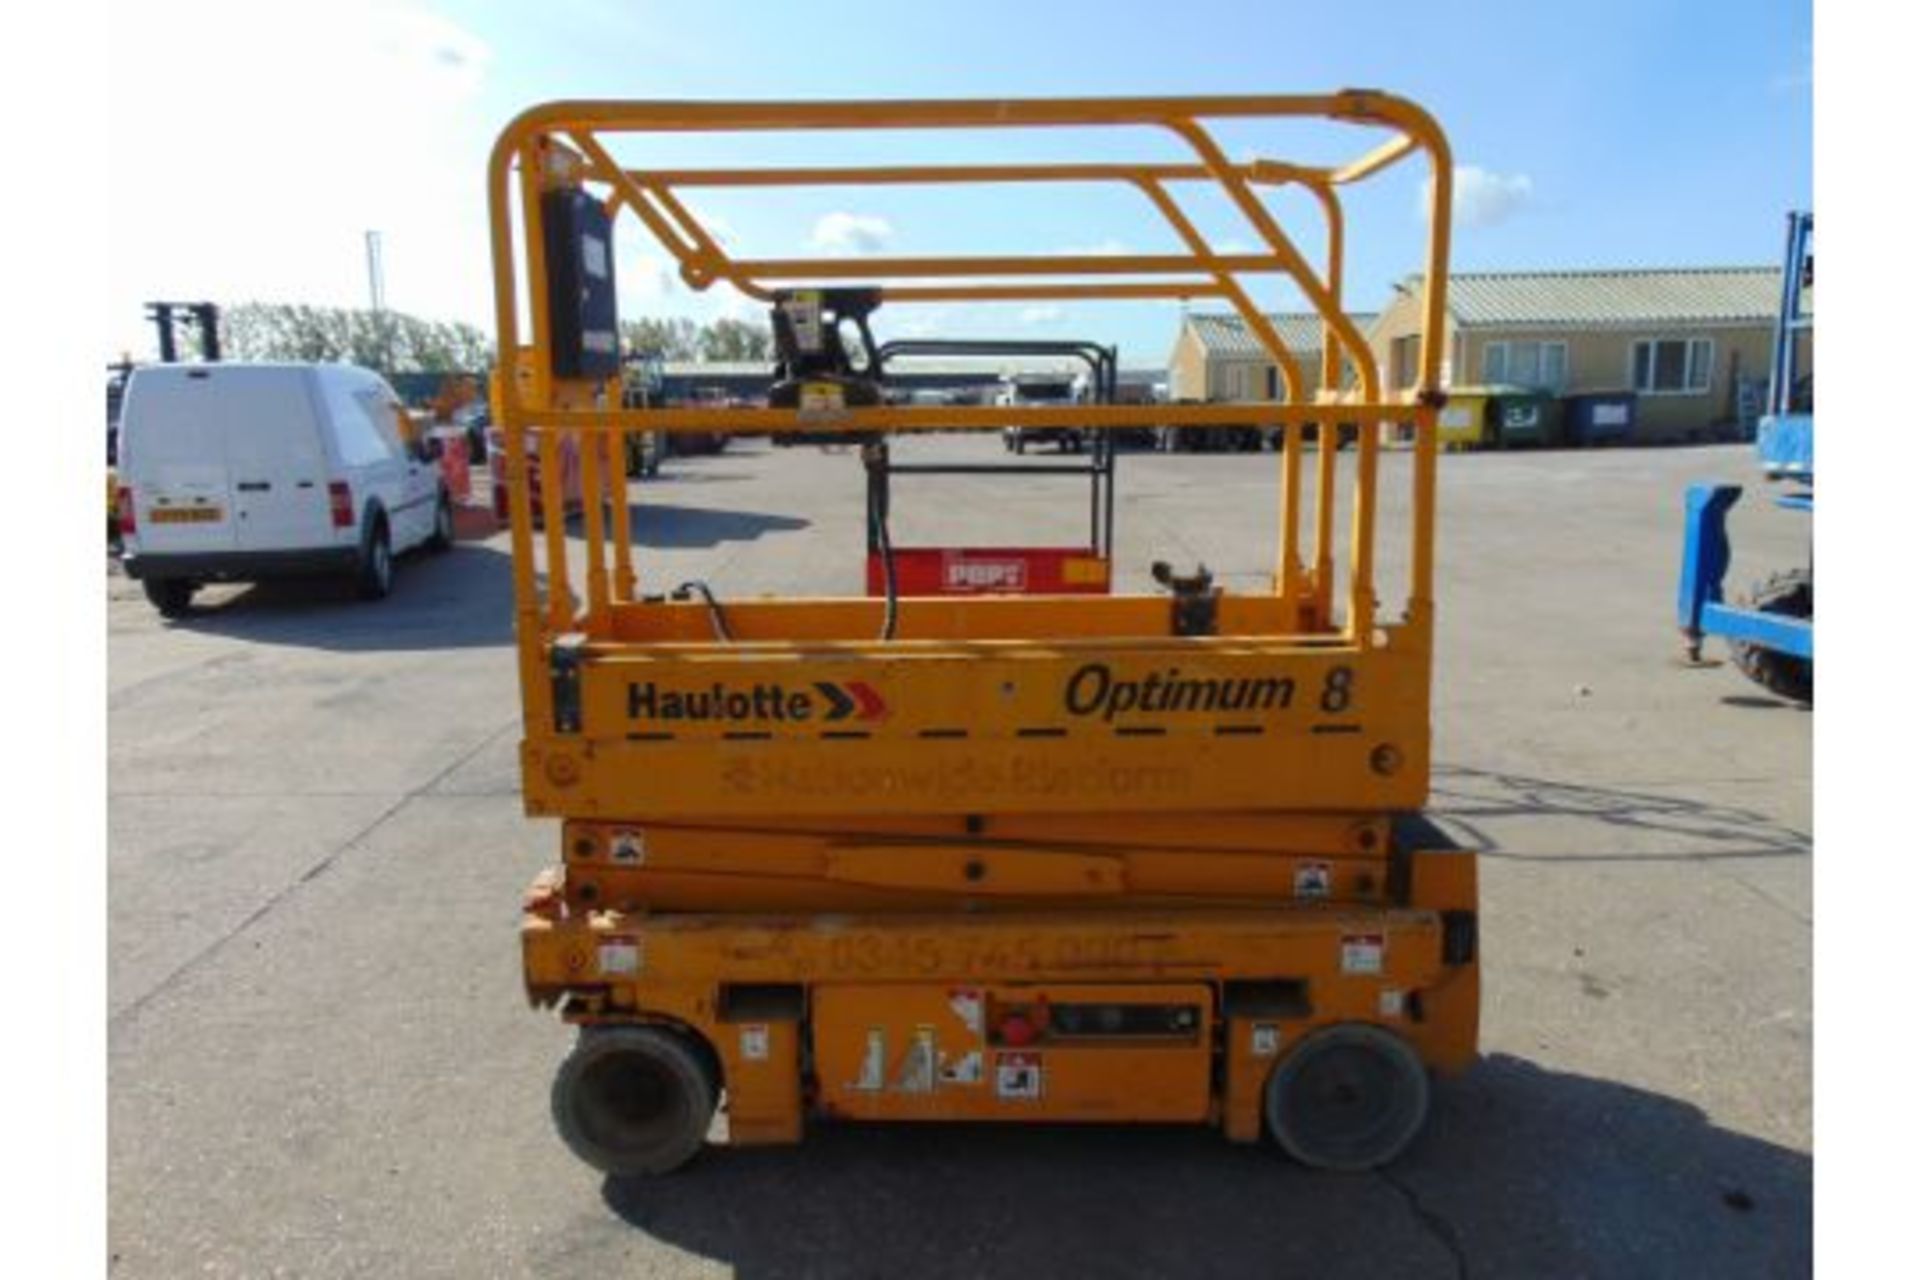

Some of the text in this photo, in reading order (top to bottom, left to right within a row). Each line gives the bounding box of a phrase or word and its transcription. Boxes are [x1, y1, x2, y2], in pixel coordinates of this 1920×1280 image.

[626, 682, 812, 720] Haulotte
[1065, 663, 1352, 721] Optimum 8
